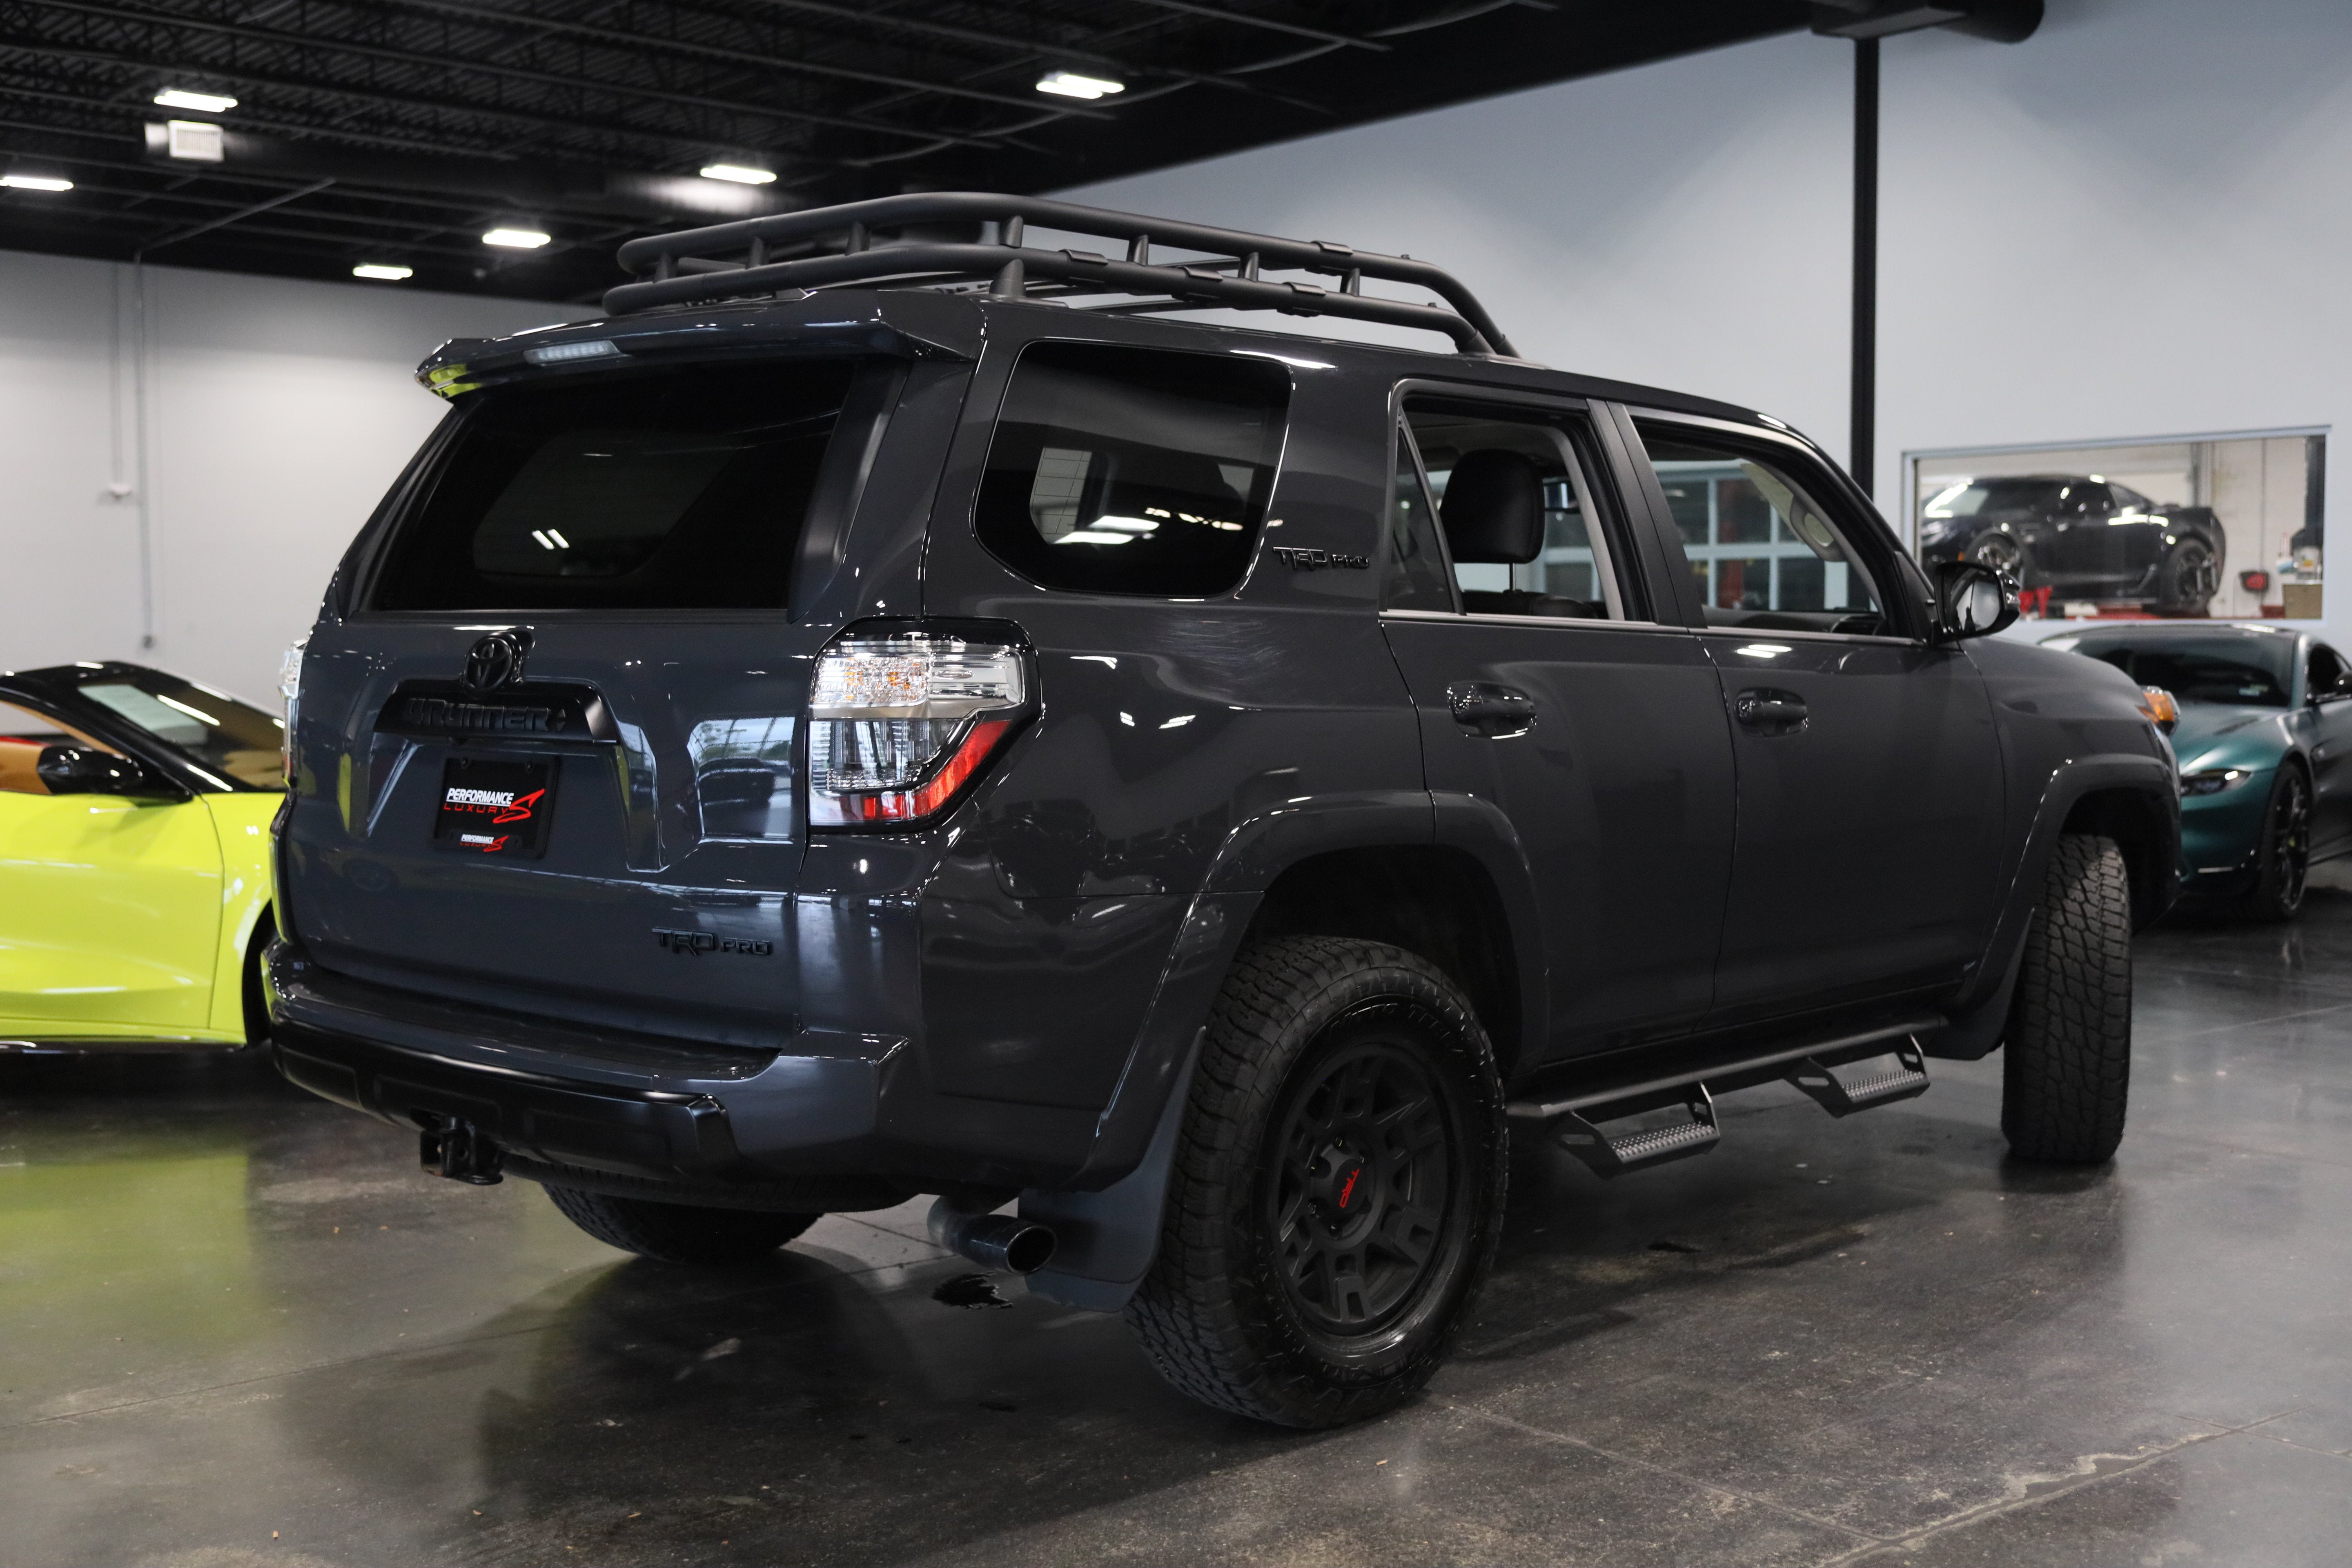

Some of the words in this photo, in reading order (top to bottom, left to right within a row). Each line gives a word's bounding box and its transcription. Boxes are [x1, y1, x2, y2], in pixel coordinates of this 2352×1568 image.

[1273, 546, 1327, 570] TRD
[447, 788, 514, 805] PERFORMANCE
[443, 802, 508, 815] LUXURY
[461, 834, 494, 844] PERFORMANCE
[652, 927, 716, 956] TRD
[721, 938, 771, 955] PRO
